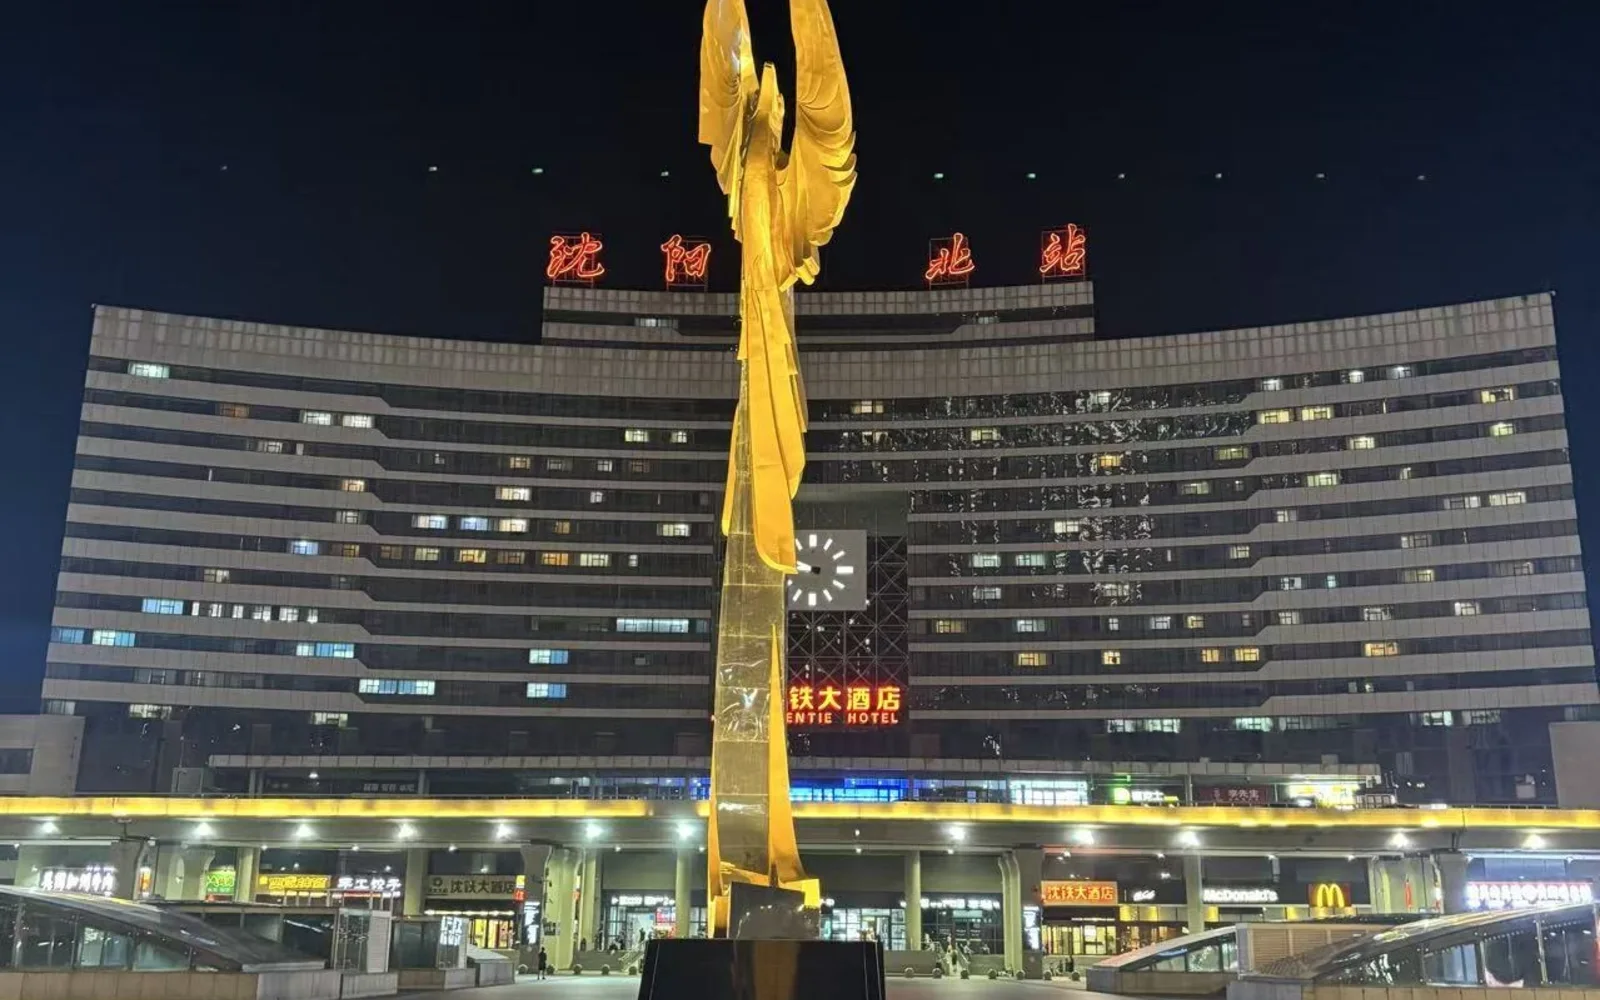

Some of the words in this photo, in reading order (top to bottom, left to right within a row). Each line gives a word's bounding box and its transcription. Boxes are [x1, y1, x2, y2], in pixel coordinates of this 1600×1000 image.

[547, 223, 1086, 282] 沈阳北站
[847, 712, 898, 724] HOTEL
[449, 879, 515, 894] 沈铁大酒店
[1047, 886, 1114, 901] 沈铁大酒店
[1202, 889, 1278, 902] McDonald's
